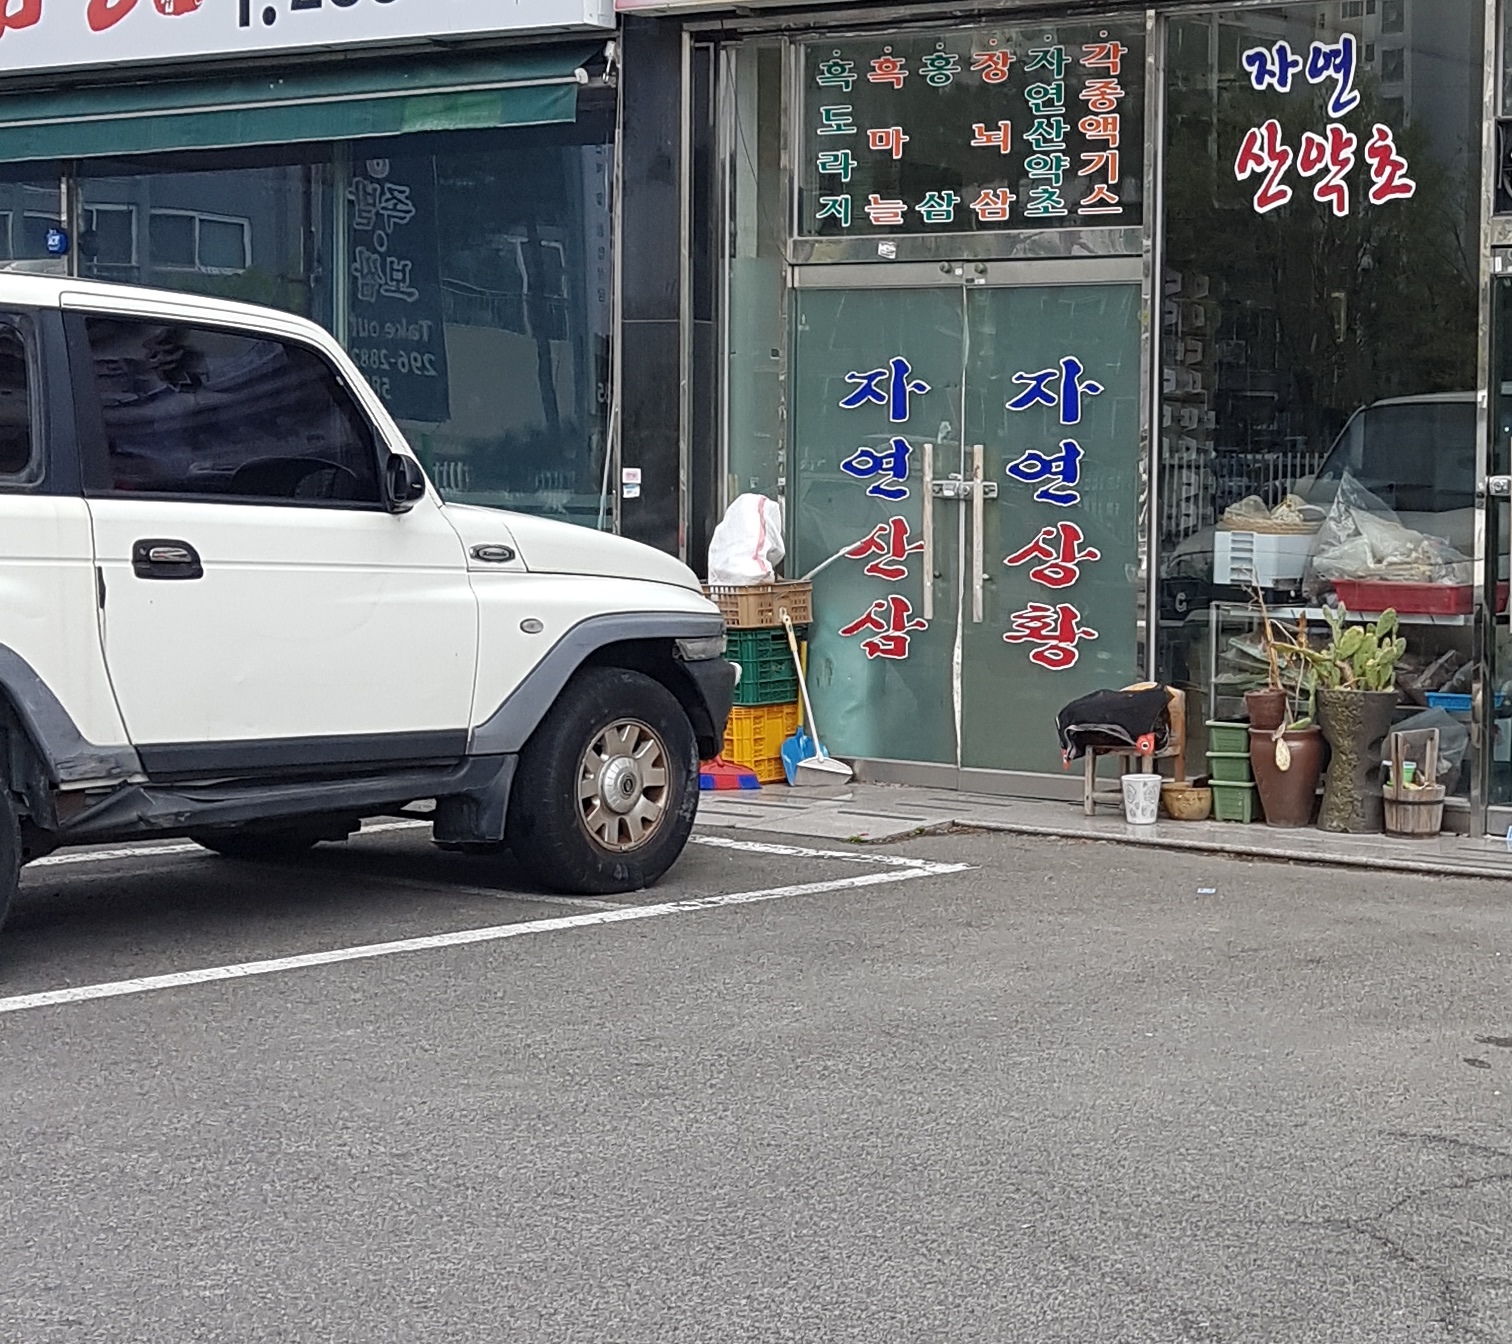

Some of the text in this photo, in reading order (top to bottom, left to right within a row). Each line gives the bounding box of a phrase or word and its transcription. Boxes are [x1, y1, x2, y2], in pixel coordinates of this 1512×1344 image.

[816, 59, 857, 228] 흑도라지
[865, 56, 909, 225] 흑마늘
[970, 50, 1016, 222] 장뇌삼
[1023, 45, 1072, 218] 자연산약초
[1242, 33, 1360, 118] 자연
[1234, 119, 1417, 216] 산약초
[839, 356, 931, 661] 자연산삼
[1003, 356, 1104, 672] 자연상황
